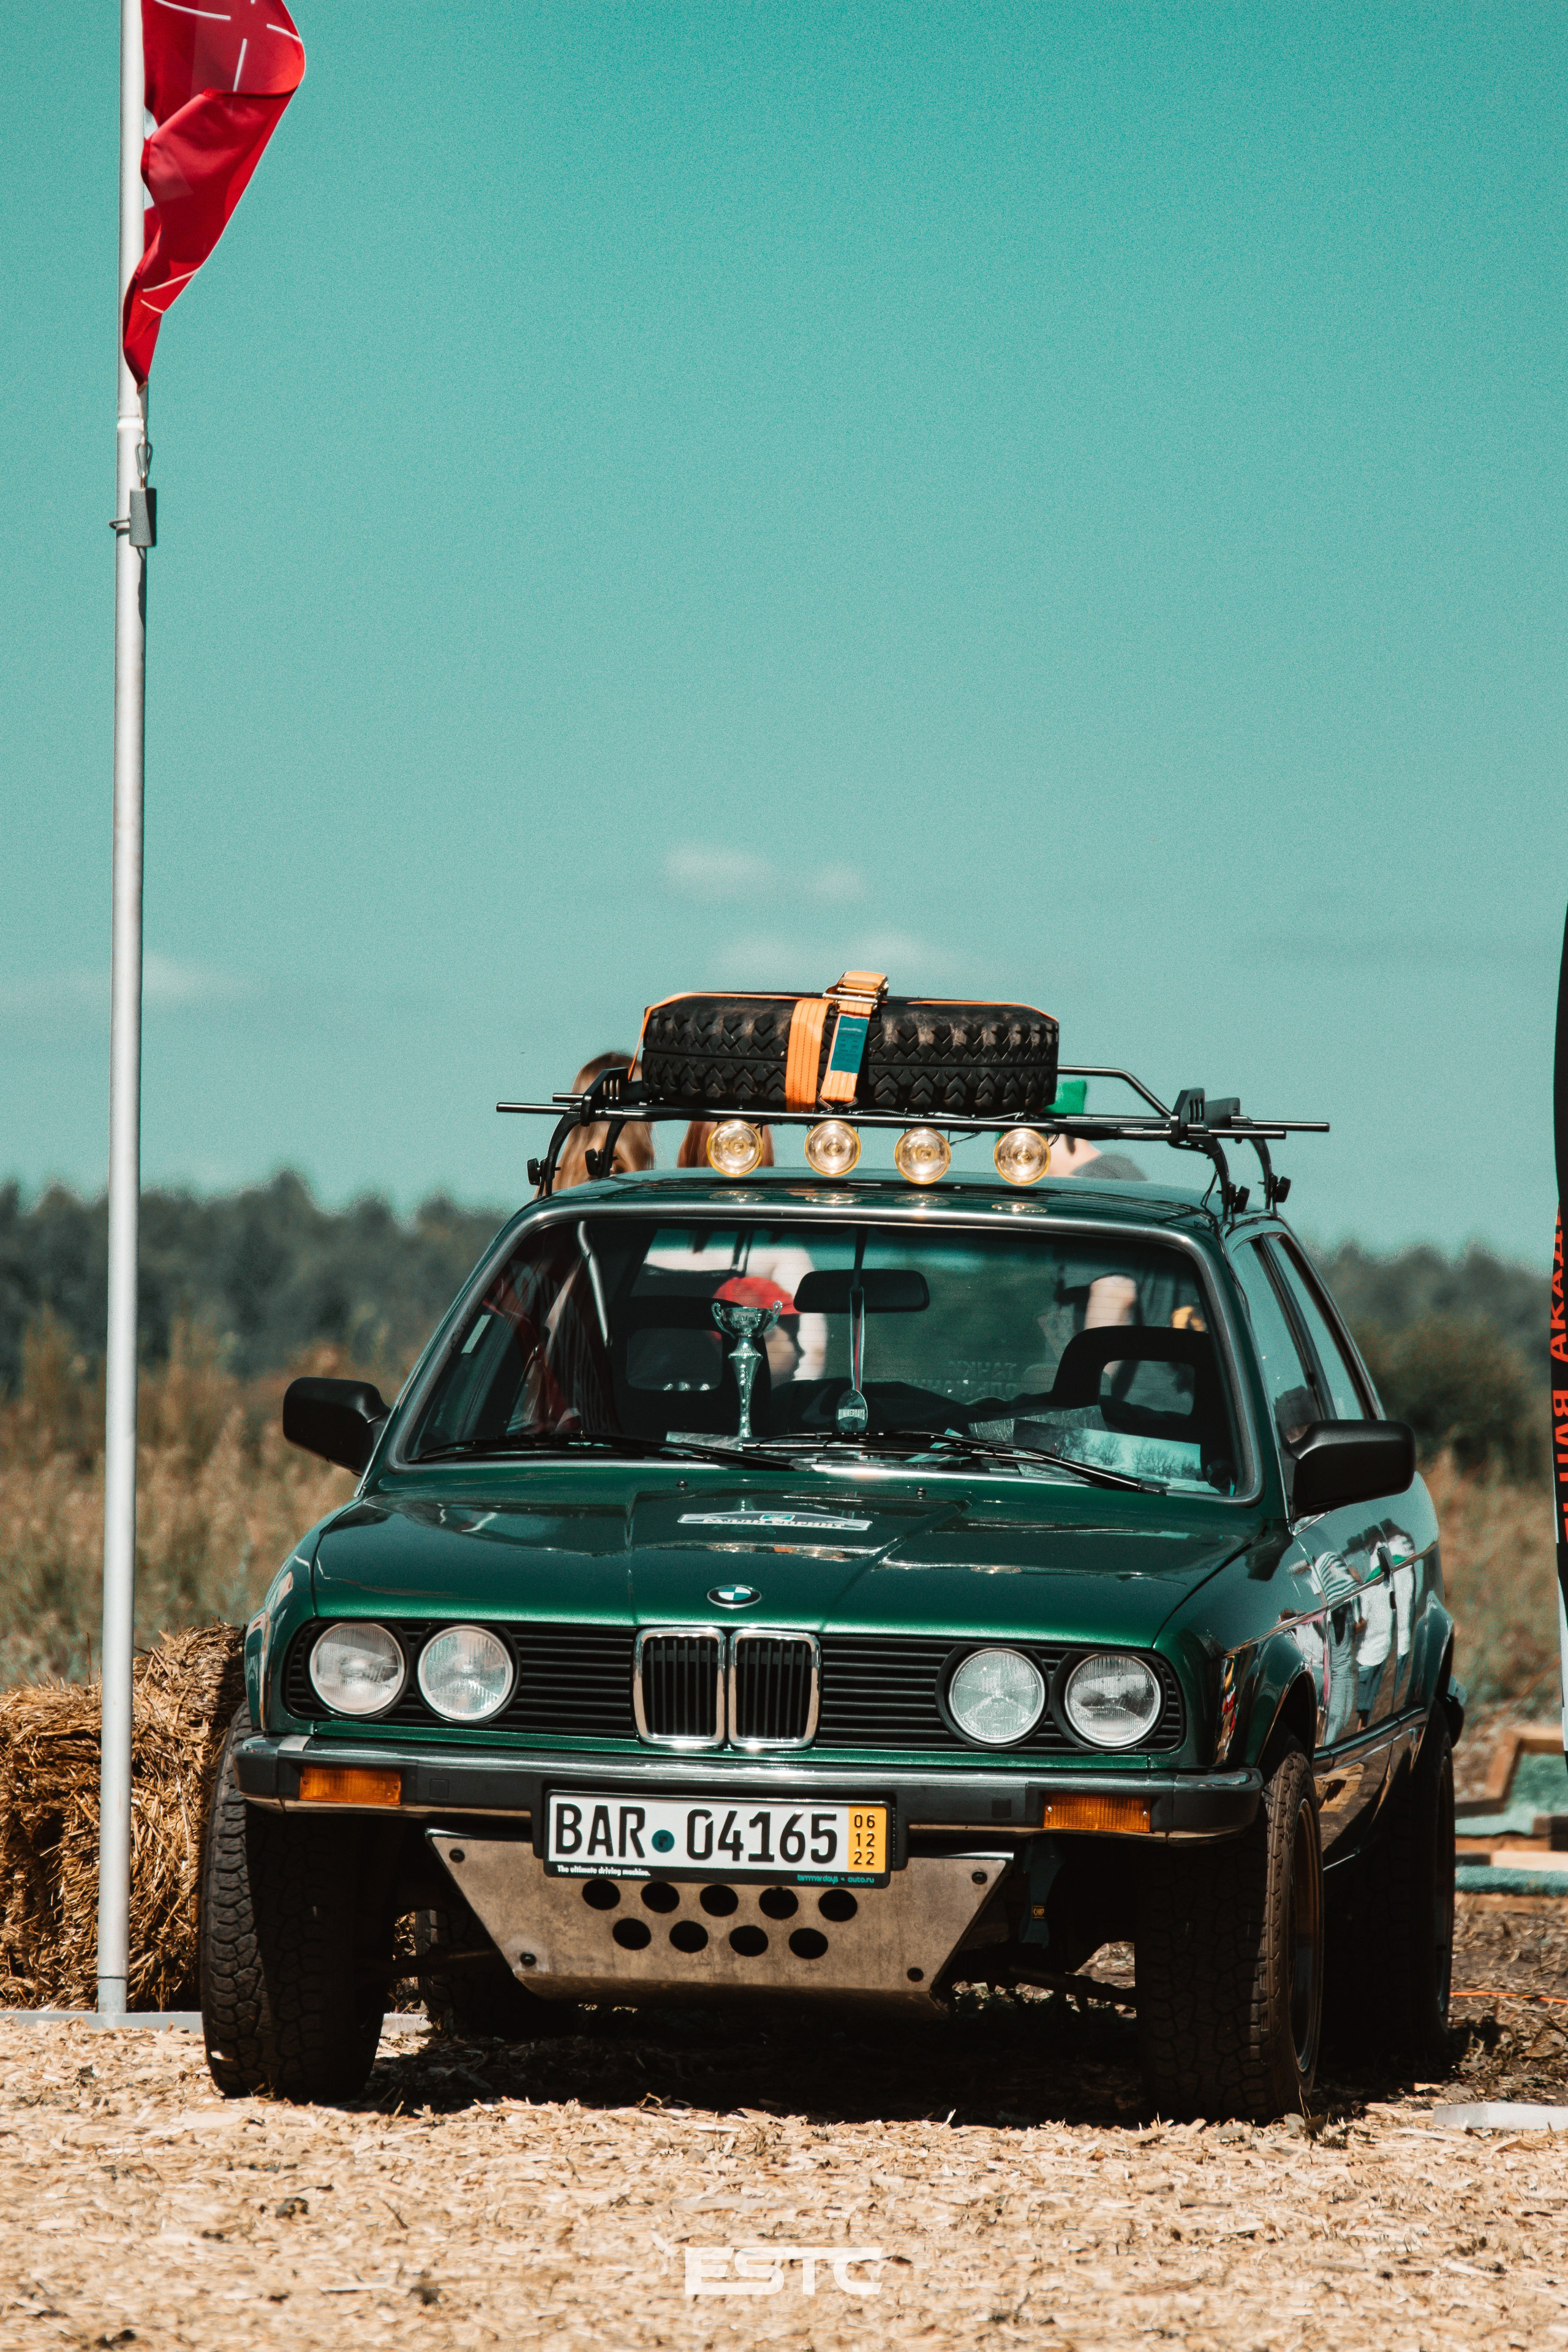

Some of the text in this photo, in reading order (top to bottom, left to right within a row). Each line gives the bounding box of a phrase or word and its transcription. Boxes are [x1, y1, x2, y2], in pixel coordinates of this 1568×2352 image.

[854, 1814, 875, 1828] 06
[556, 1803, 837, 1864] BAR 04165
[856, 1833, 875, 1847] 12
[853, 1851, 875, 1865] 22
[557, 1864, 569, 1873] The
[570, 1865, 598, 1874] ultimate
[598, 1866, 621, 1876] driving
